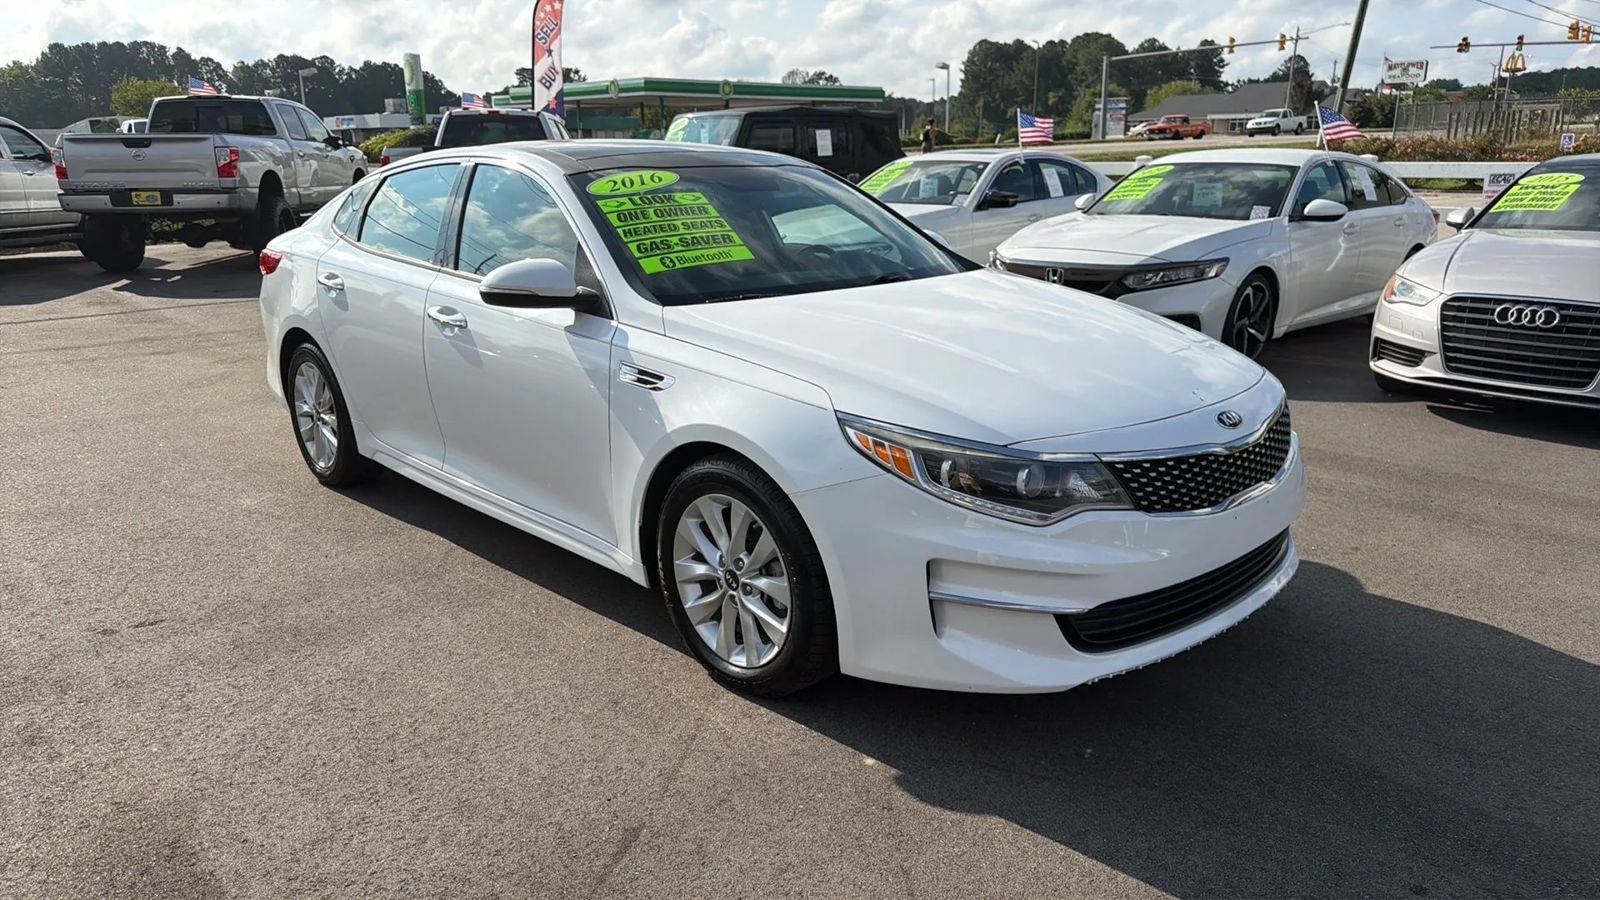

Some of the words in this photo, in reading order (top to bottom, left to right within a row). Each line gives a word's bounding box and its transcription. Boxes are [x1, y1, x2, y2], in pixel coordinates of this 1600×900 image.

[535, 16, 559, 45] SELL
[1387, 61, 1424, 71] MAYFLOWER
[540, 65, 559, 90] BUY
[605, 172, 663, 193] 2016
[627, 193, 679, 207] LOOK
[616, 208, 651, 223] ONE
[653, 205, 710, 219] OWNER
[622, 222, 680, 239] HEATED
[681, 219, 727, 231] SEATS
[636, 233, 735, 254] GAS-SAVER
[675, 250, 732, 265] Bluetooth
[1218, 411, 1241, 425] KIA
